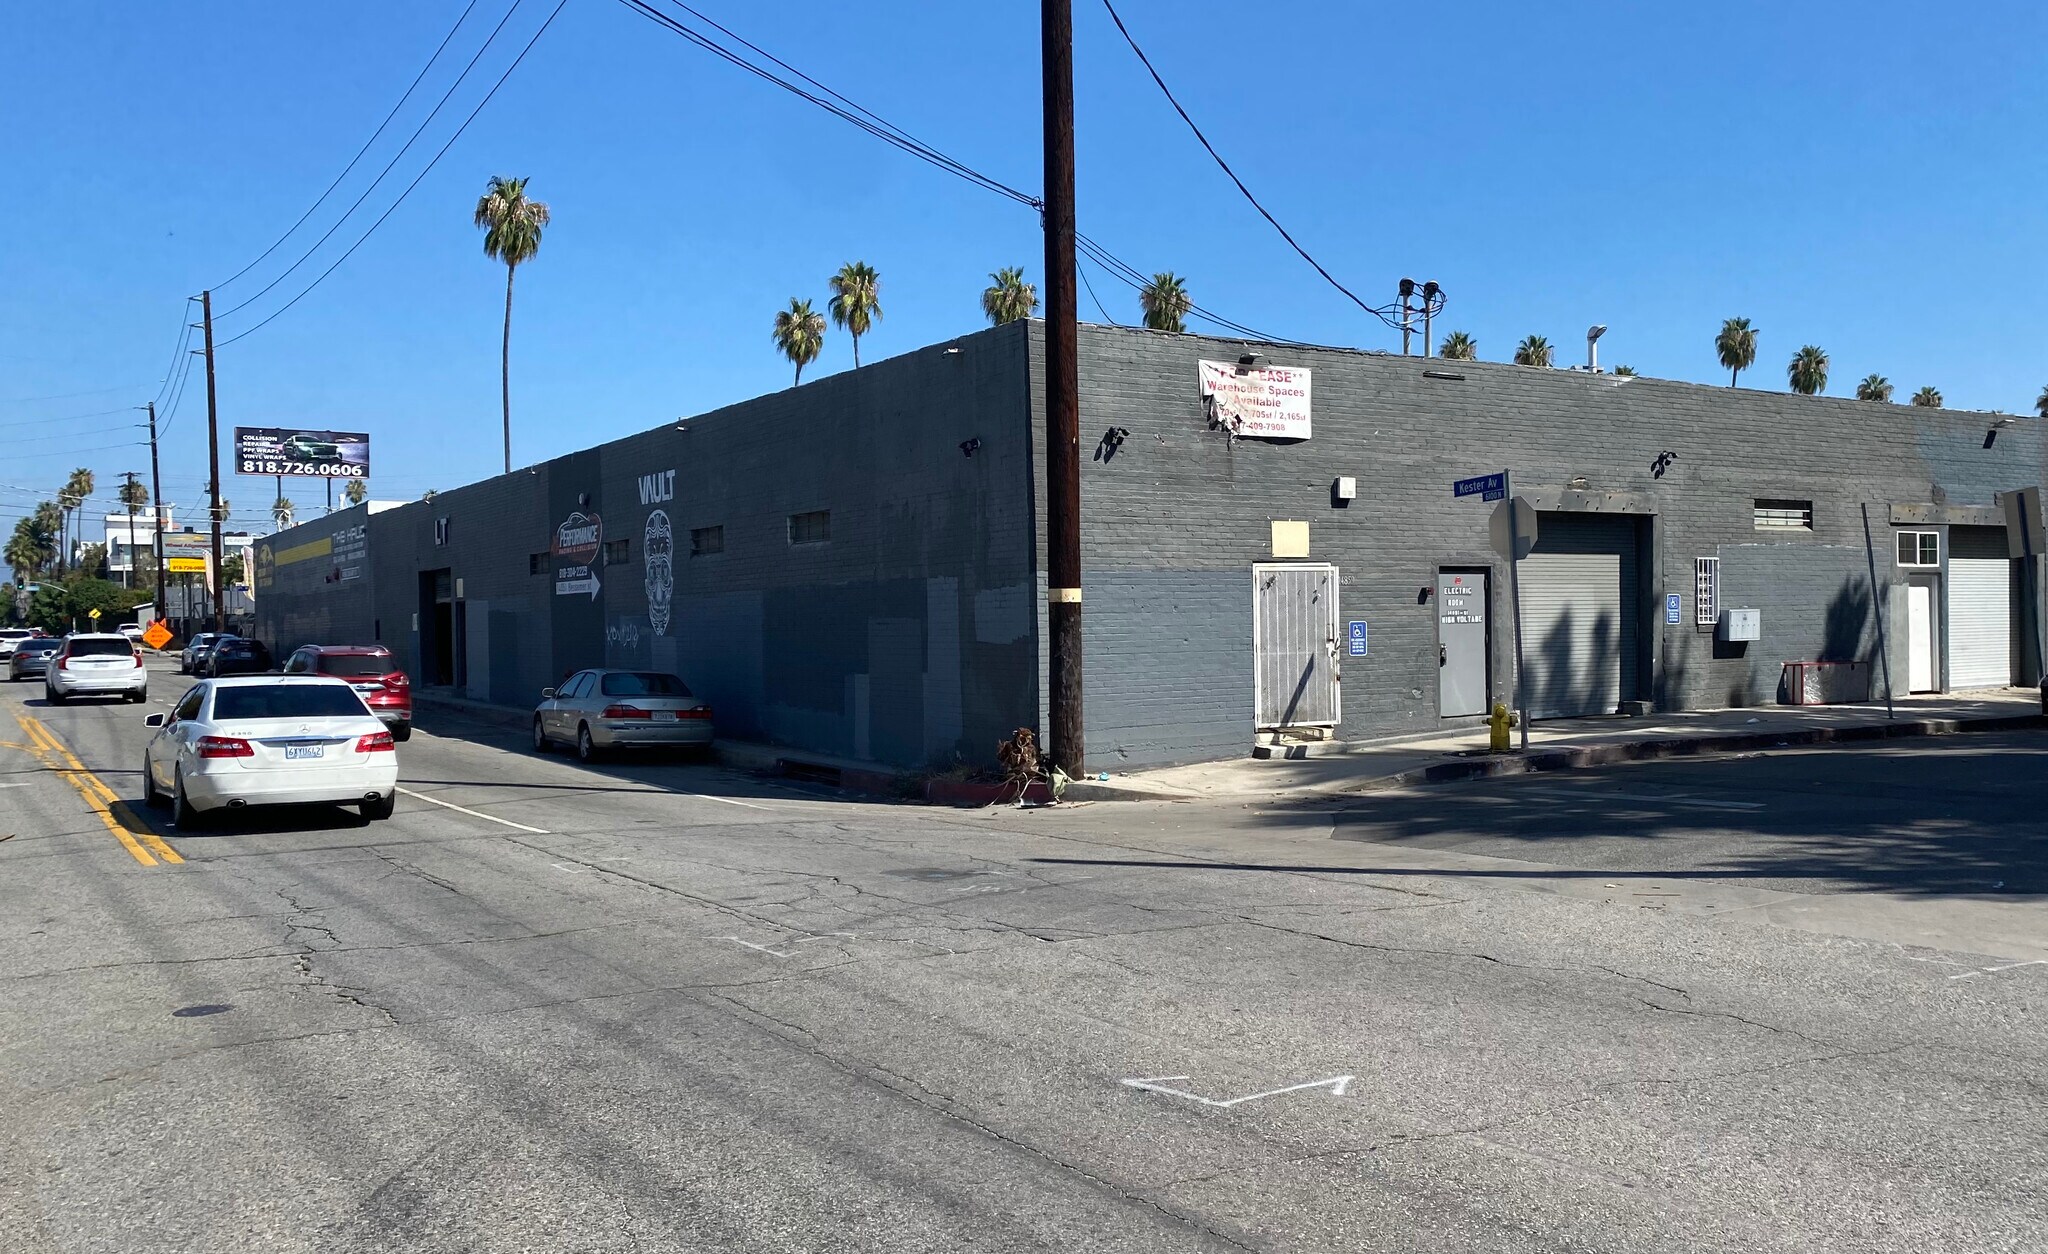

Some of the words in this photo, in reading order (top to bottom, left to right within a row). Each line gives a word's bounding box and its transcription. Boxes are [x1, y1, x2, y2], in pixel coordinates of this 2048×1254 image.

[1207, 380, 1265, 394] Warehouse
[1268, 385, 1305, 398] Spaces
[1233, 395, 1282, 408] Available
[243, 461, 362, 476] 818.726.0606
[638, 469, 676, 505] VAULT
[1459, 480, 1485, 494] Kester
[1487, 477, 1498, 489] Av
[559, 524, 598, 547] PERFORMANCE
[1444, 587, 1472, 595] ELECTRIC
[1441, 616, 1456, 624] HIGH
[1456, 615, 1483, 623] VOLTAGE
